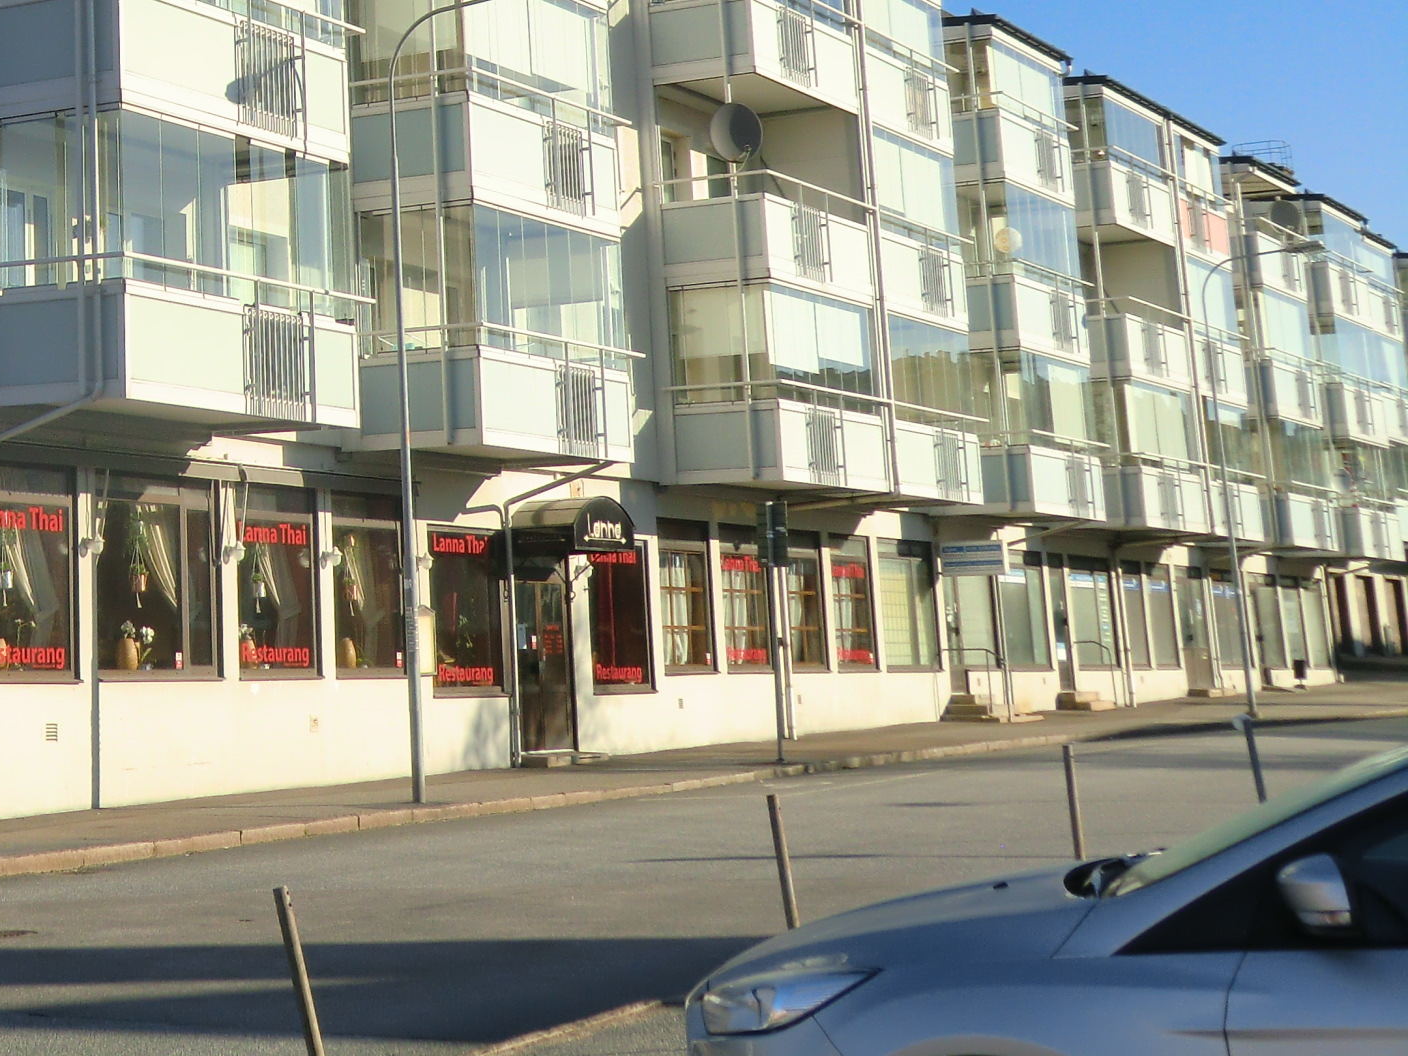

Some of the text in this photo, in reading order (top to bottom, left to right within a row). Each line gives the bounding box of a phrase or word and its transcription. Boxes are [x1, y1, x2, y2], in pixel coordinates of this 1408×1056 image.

[28, 506, 63, 532] Thai
[586, 512, 622, 539] Lanna
[237, 520, 307, 546] Lanna Thai
[433, 532, 465, 553] Lanna
[241, 642, 310, 668] Restaurang
[438, 664, 494, 684] Restaurang
[596, 663, 643, 683] Restaurang
